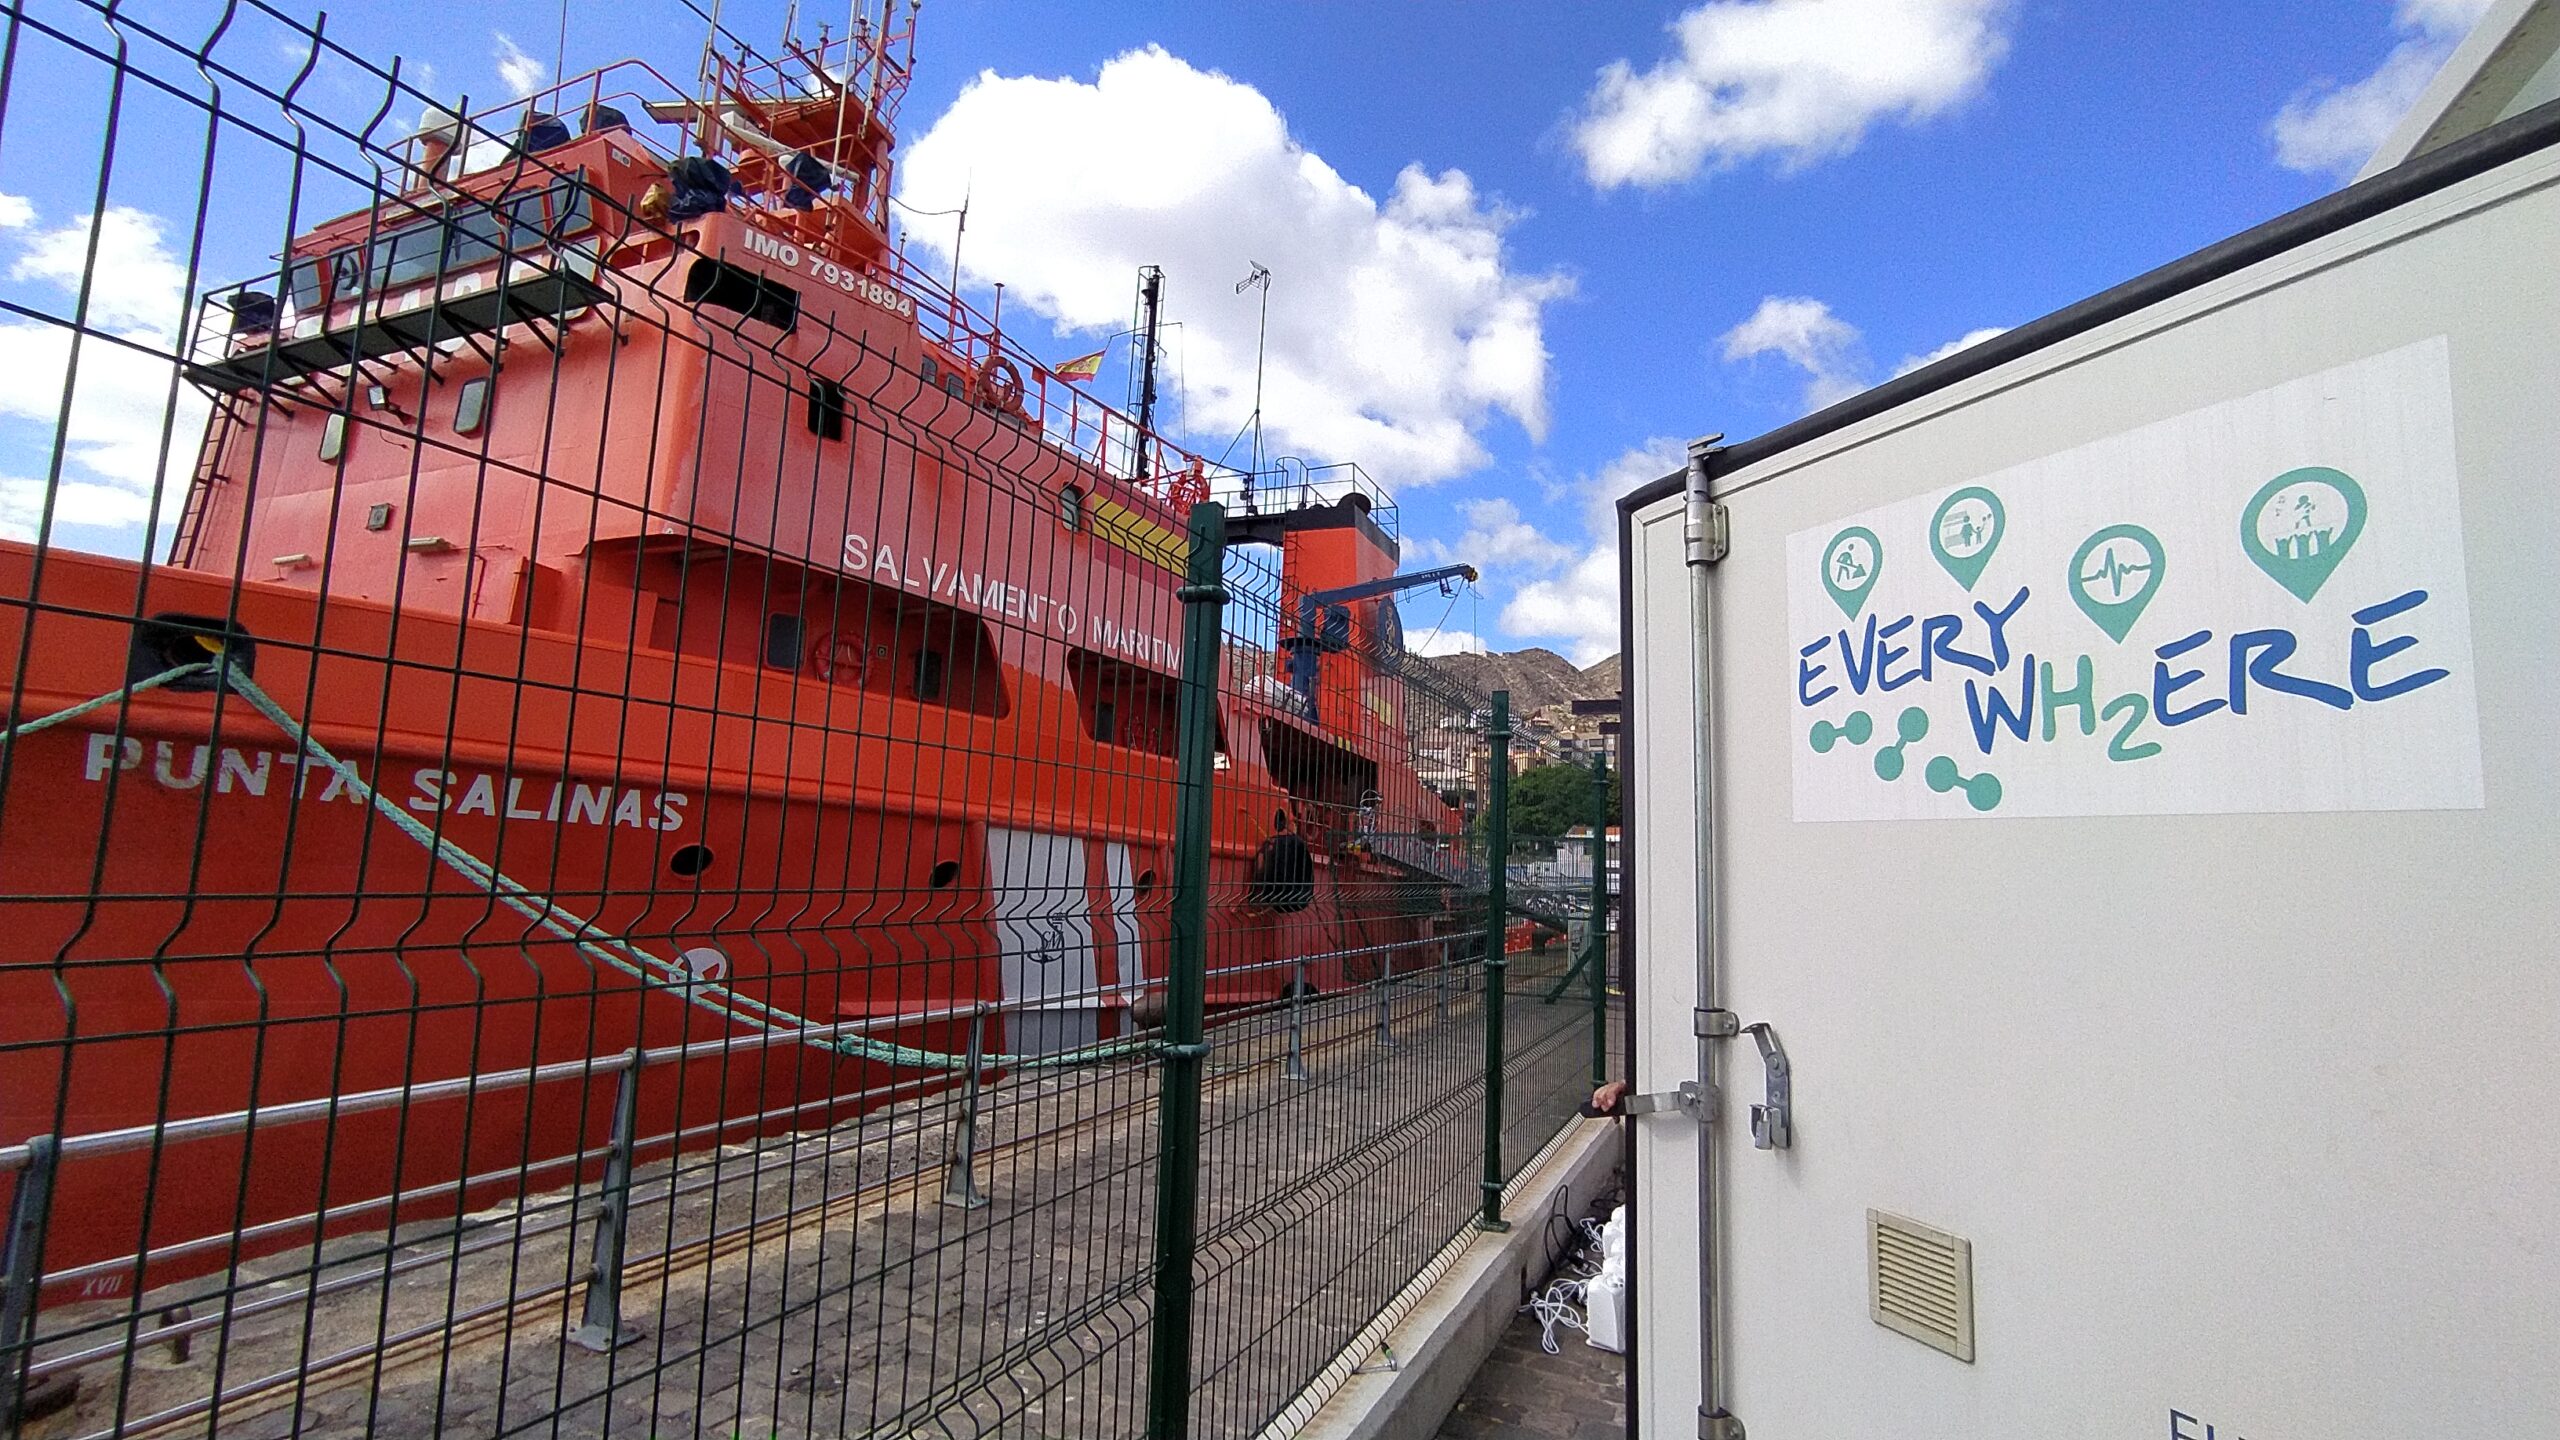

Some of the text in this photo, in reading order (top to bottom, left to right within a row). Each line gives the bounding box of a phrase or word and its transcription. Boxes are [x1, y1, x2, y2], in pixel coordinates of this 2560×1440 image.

[743, 229, 912, 318] IMO 7931894
[1093, 615, 1182, 671] MARITIM
[1799, 586, 2030, 706] EVERY
[84, 732, 688, 832] PUNTA SALINAS
[82, 1274, 124, 1296] XVII
